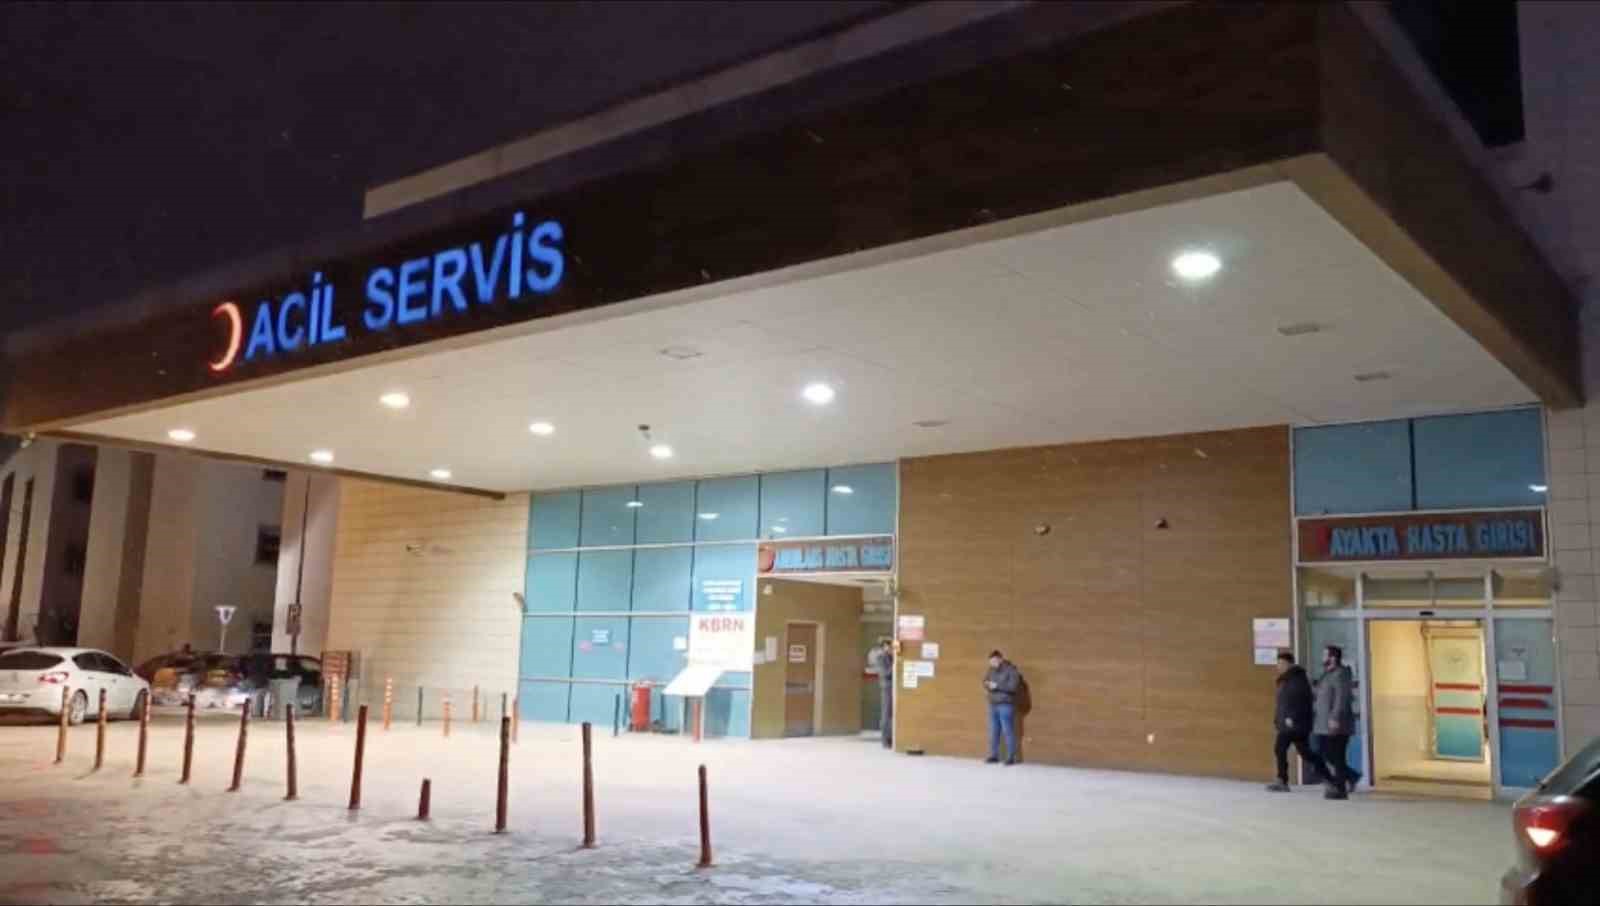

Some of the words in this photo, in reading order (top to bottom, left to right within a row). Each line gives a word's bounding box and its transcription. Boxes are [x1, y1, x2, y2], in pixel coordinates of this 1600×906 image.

[244, 271, 347, 361] ACİL
[361, 211, 565, 331] SERVİS
[1330, 526, 1399, 556] AYAKTA
[1406, 522, 1468, 553] HASTA
[698, 616, 745, 633] KBRN
